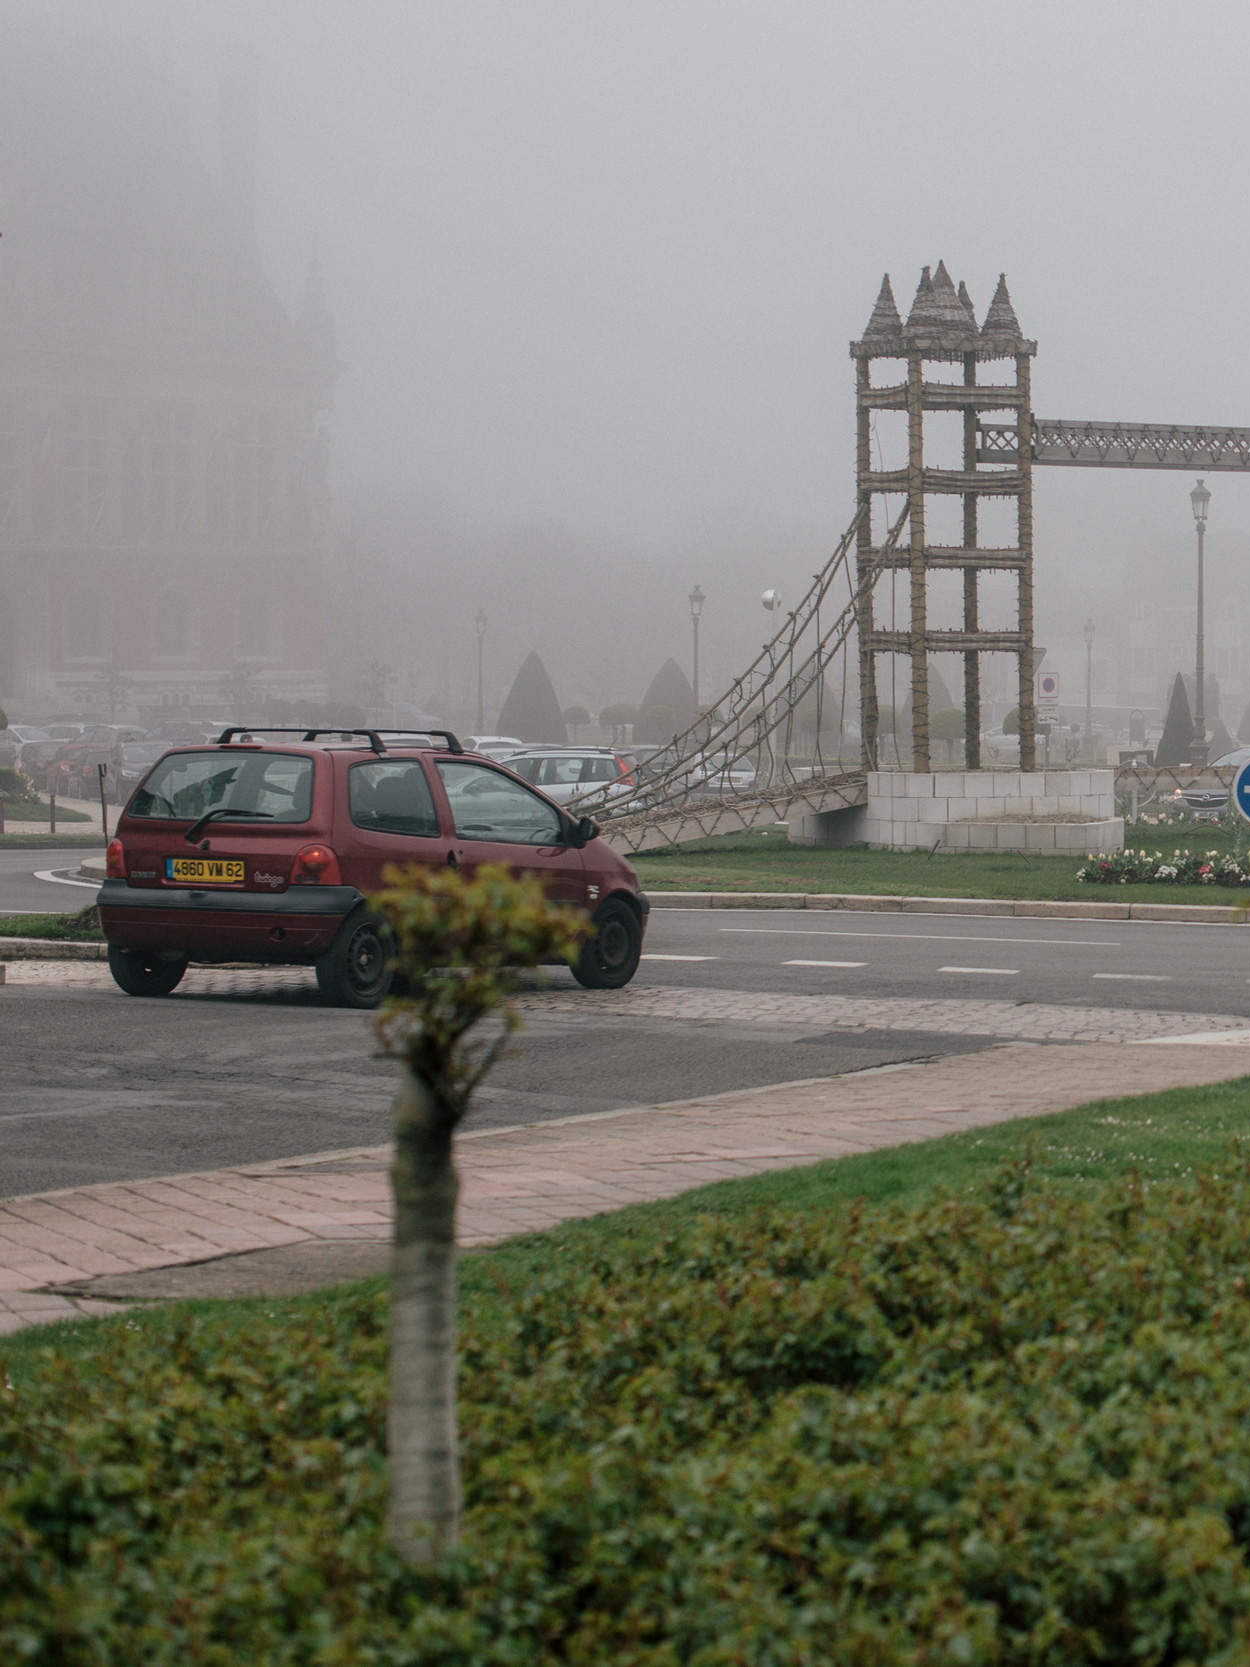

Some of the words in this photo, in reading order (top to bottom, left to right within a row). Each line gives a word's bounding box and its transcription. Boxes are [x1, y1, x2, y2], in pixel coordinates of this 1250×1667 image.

[173, 861, 204, 876] 4860
[207, 861, 223, 877] VM
[225, 862, 243, 878] 62
[253, 871, 285, 888] twingo
